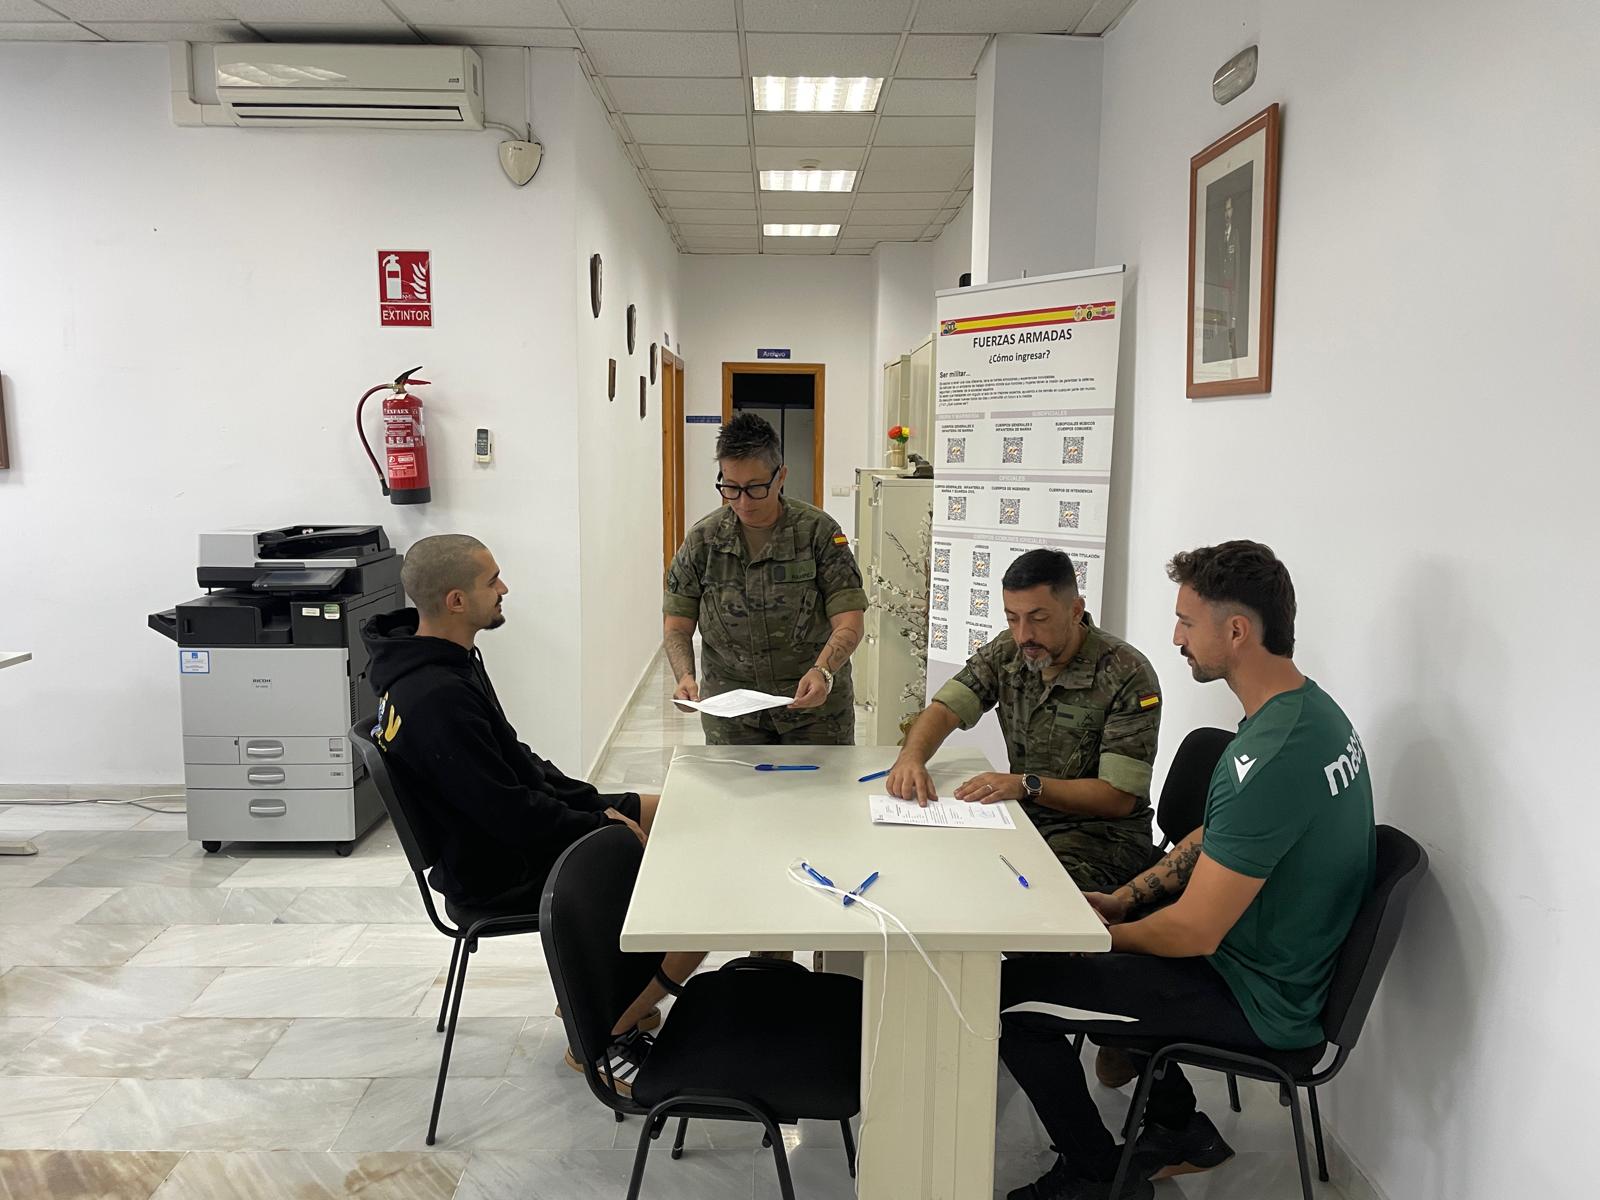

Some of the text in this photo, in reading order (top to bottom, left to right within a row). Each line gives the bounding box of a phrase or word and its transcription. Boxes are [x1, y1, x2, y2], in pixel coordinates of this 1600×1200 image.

[382, 310, 430, 321] EXTINTOR
[973, 328, 1073, 349] FUERZAS ARMADAS
[988, 349, 1051, 364] ¿Cómo ingresar?
[939, 371, 948, 379] Ser
